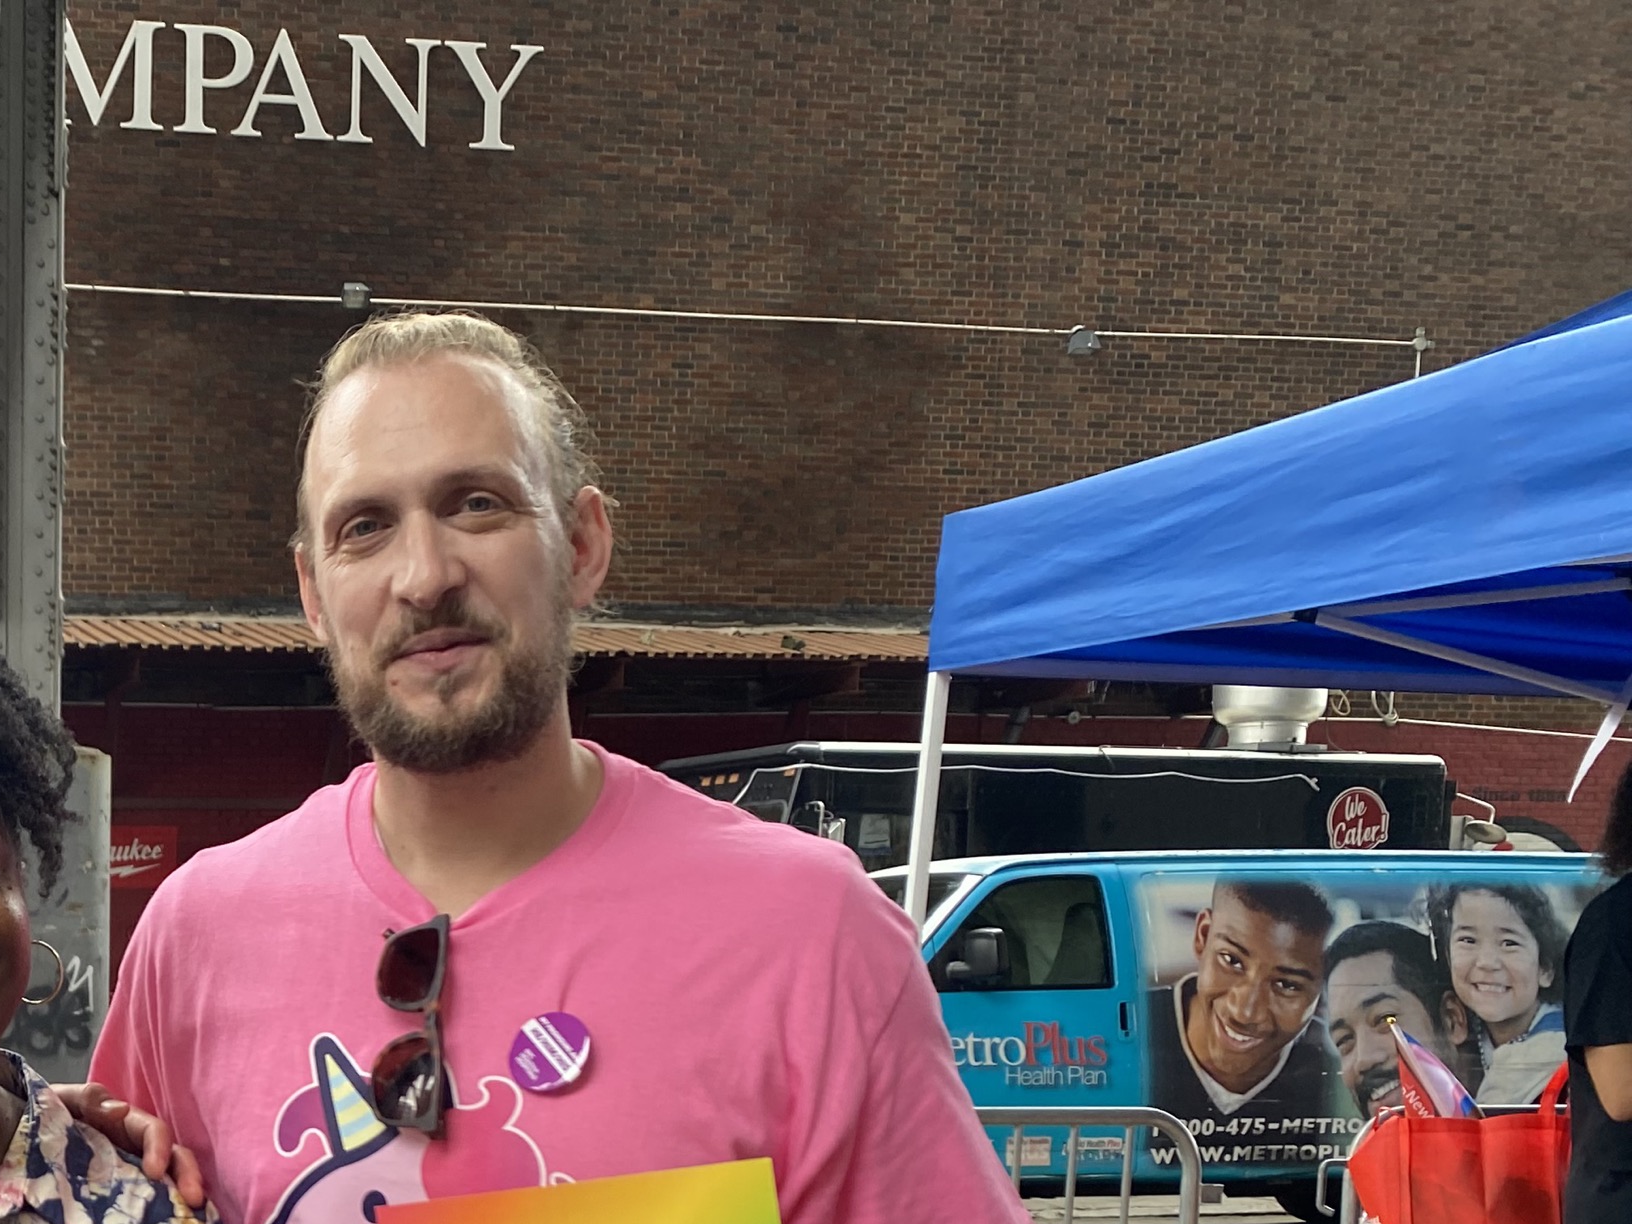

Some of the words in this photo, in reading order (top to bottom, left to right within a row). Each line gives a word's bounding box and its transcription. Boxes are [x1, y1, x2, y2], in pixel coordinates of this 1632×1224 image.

[64, 18, 544, 151] MPANY
[1344, 793, 1367, 821] We
[1333, 814, 1386, 849] Cater!
[950, 1020, 1108, 1066] etroPlus
[1005, 1066, 1064, 1086] Health
[1068, 1065, 1107, 1085] Plan
[1150, 1144, 1350, 1165] WW.METROPL
